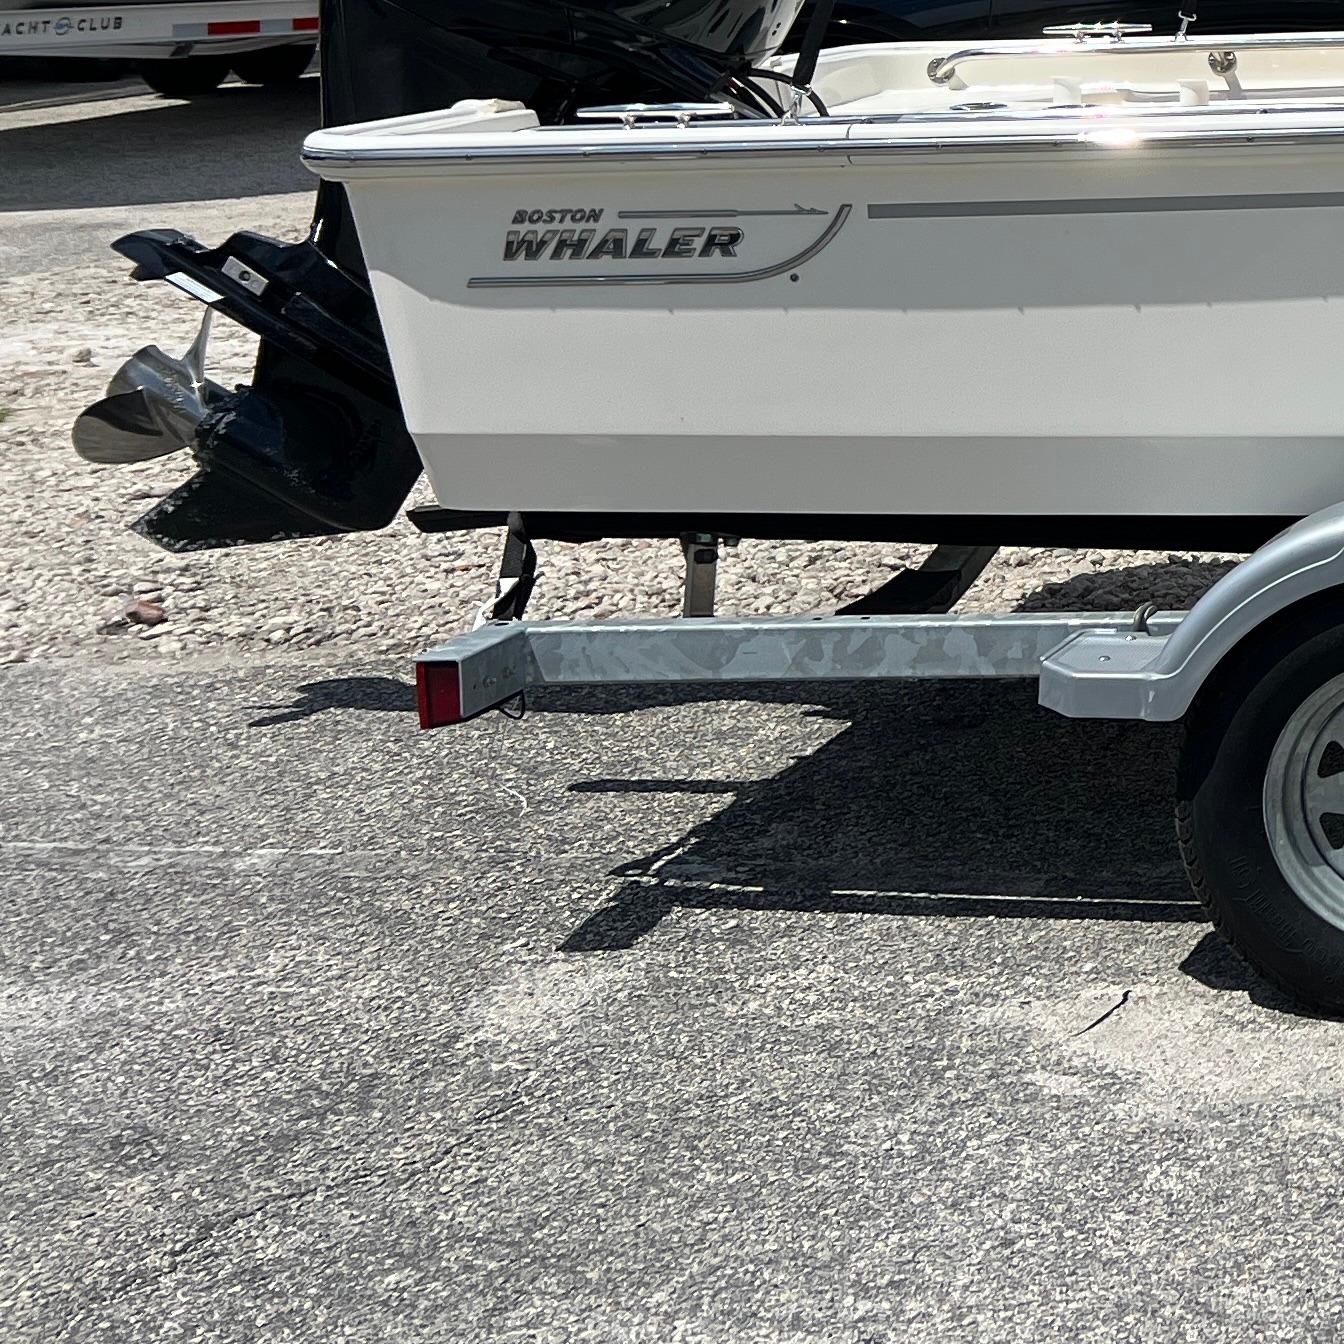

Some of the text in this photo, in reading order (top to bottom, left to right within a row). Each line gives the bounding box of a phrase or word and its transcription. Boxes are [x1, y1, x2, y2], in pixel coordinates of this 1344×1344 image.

[0, 16, 123, 36] ACHT CLUB
[512, 208, 604, 225] BOSTON
[503, 226, 745, 262] WHALER
